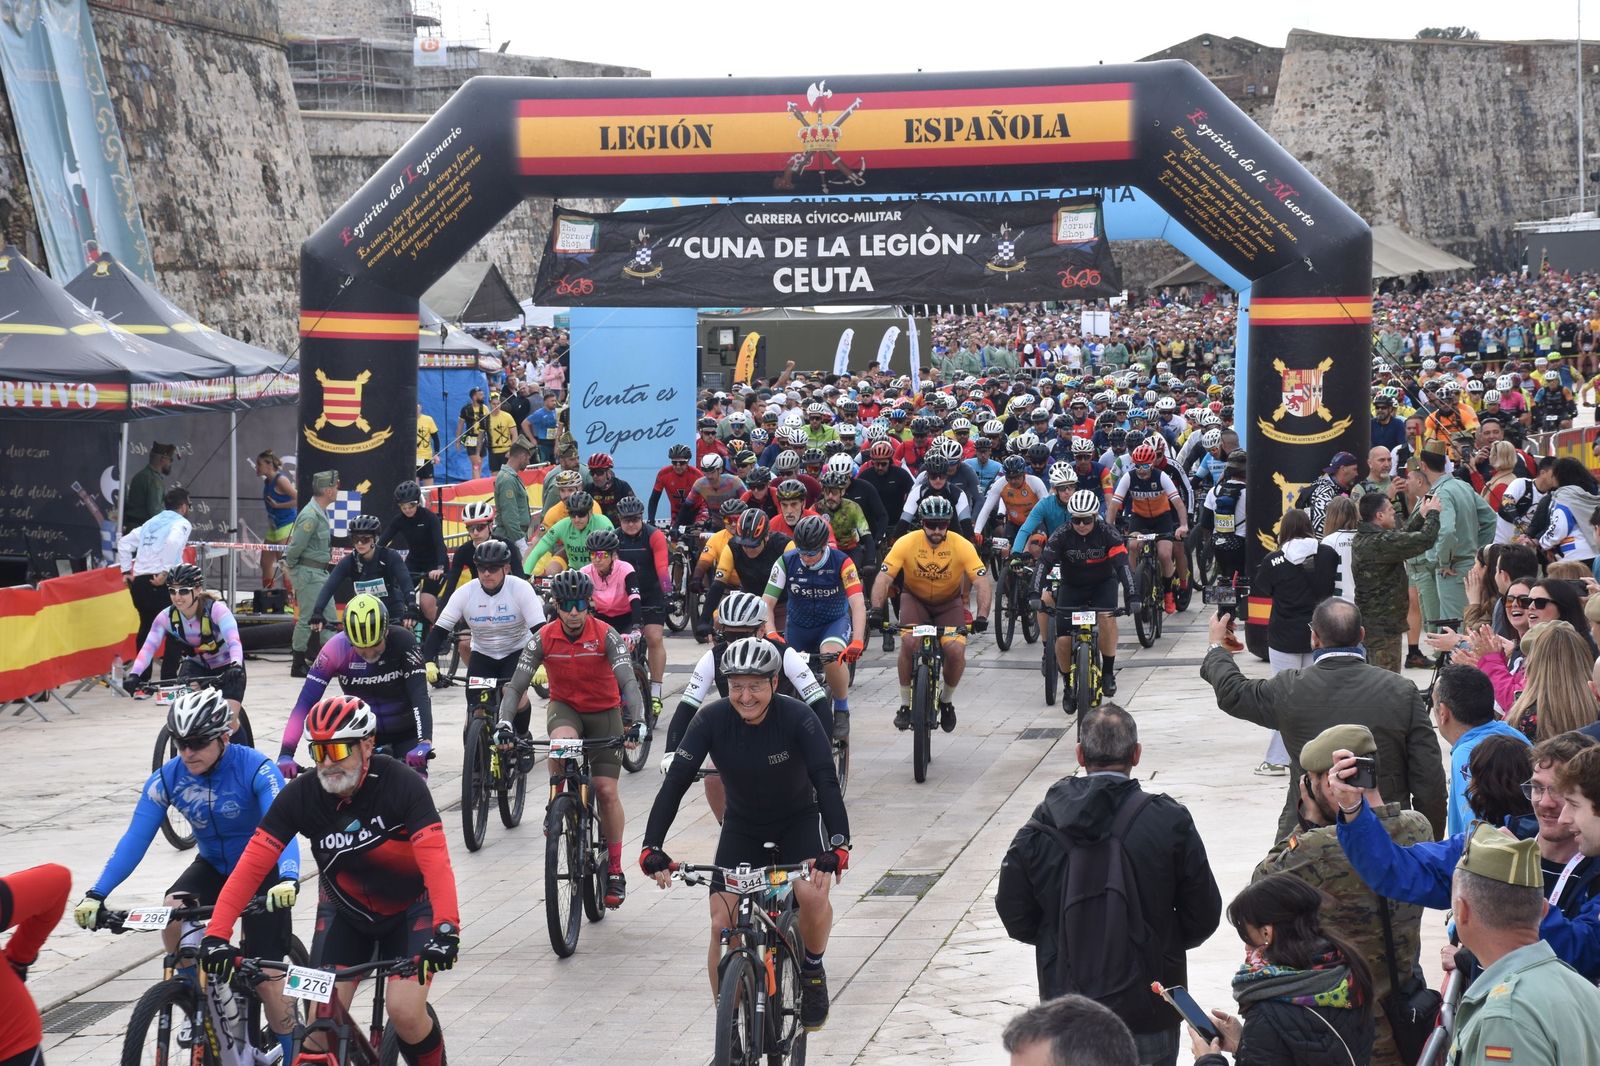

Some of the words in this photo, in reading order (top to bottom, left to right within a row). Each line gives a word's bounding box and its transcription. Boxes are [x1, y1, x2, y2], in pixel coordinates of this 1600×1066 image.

[599, 118, 713, 150] LEGIÓN
[904, 109, 1071, 144] ESPAÑOLA
[1187, 107, 1239, 159] Espíritu
[1238, 159, 1255, 171] de
[1252, 169, 1267, 183] la
[1265, 177, 1315, 227] Muerte
[340, 198, 389, 247] Espíritu
[389, 176, 405, 200] del
[402, 127, 462, 184] Legionario
[745, 213, 802, 225] CARRERA
[806, 210, 902, 224] CÍVICO-MILITAR
[1063, 215, 1079, 223] The
[561, 223, 577, 233] The
[1062, 222, 1094, 231] Corner
[1062, 229, 1085, 239] Shop
[560, 232, 591, 241] Corner
[560, 240, 581, 249] Shop
[774, 236, 808, 258] DE
[817, 236, 851, 258] LA
[773, 266, 874, 294] CEUTA
[656, 387, 678, 402] es
[585, 418, 679, 455] Deporte
[351, 670, 404, 685] HARMAN
[741, 877, 762, 889] 344
[144, 914, 165, 923] 296
[302, 978, 328, 994] 276
